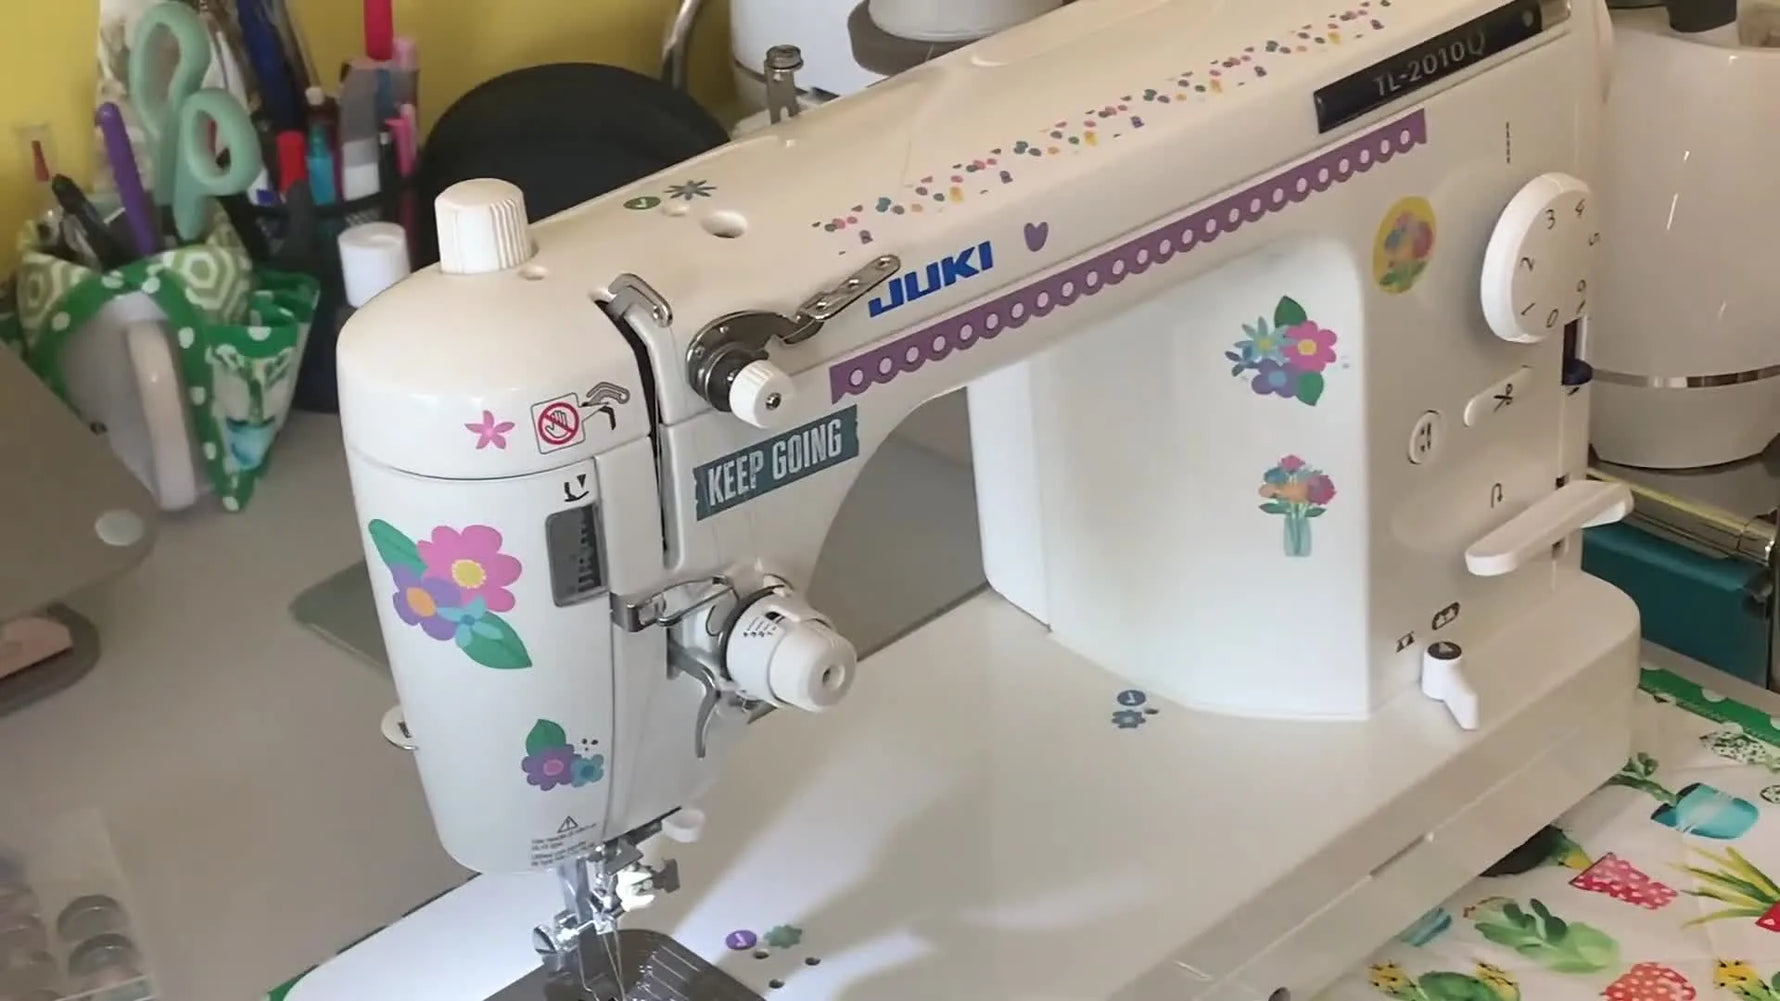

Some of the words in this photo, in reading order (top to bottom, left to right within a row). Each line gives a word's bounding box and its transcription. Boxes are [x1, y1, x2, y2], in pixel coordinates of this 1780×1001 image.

[1373, 31, 1486, 96] TL-2010Q
[1575, 198, 1586, 216] 4
[1545, 209, 1556, 230] 3
[1520, 256, 1535, 272] 2
[868, 240, 994, 318] JUKI
[1521, 302, 1536, 316] 1
[1546, 308, 1559, 328] 0
[707, 450, 764, 507] KEEP
[772, 418, 842, 481] GOING
